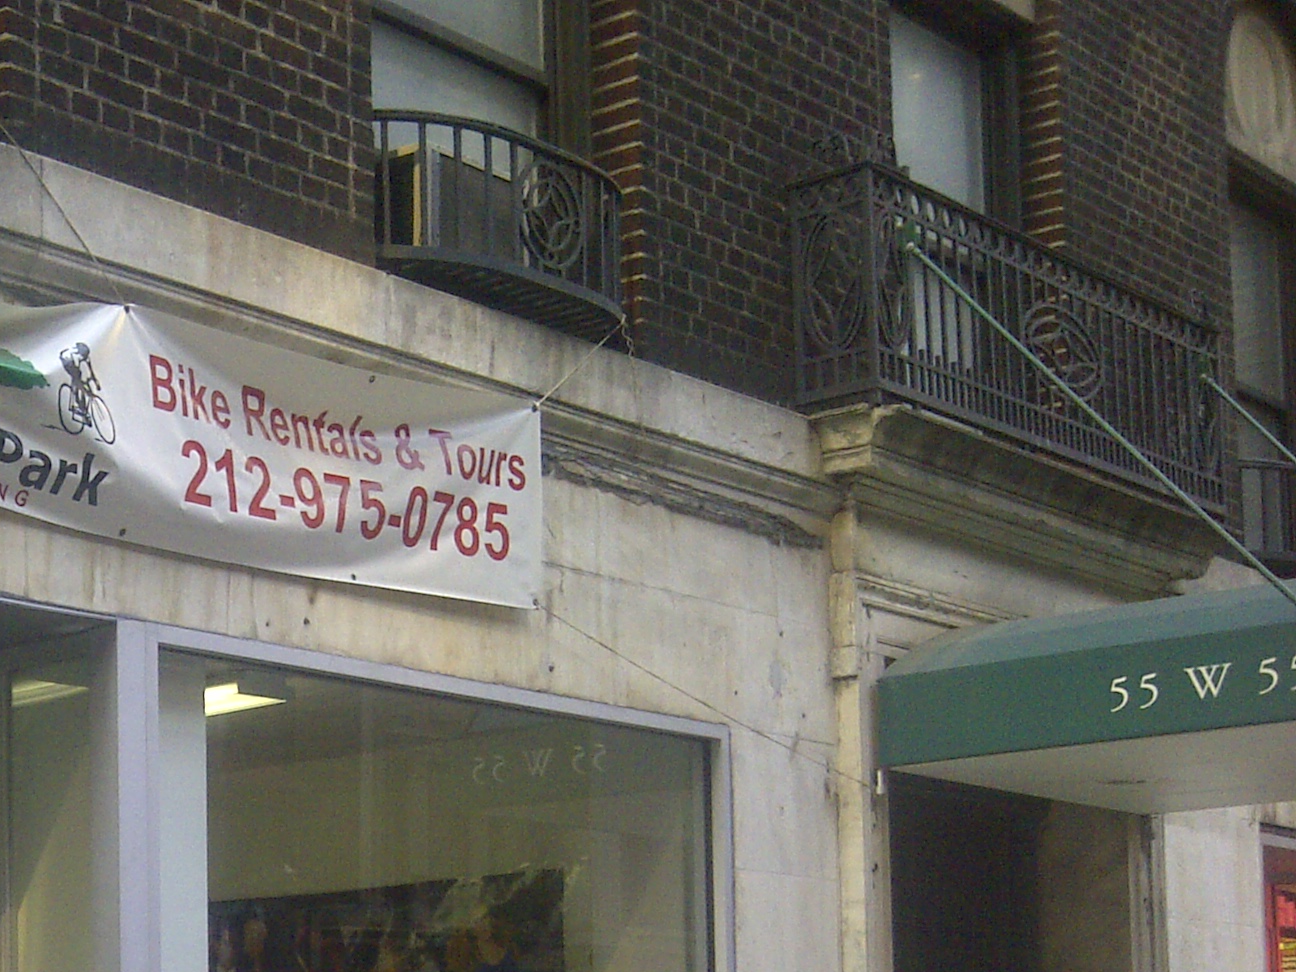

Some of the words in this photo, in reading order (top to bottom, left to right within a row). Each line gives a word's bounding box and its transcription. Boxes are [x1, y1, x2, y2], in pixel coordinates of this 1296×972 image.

[148, 354, 231, 430] Bike
[241, 385, 383, 466] Rentals
[394, 423, 425, 472] &
[428, 429, 526, 492] Tours
[181, 439, 511, 562] 212-975-0785
[1110, 673, 1159, 713] 55
[1183, 662, 1232, 700] W
[1259, 655, 1296, 695] 5
